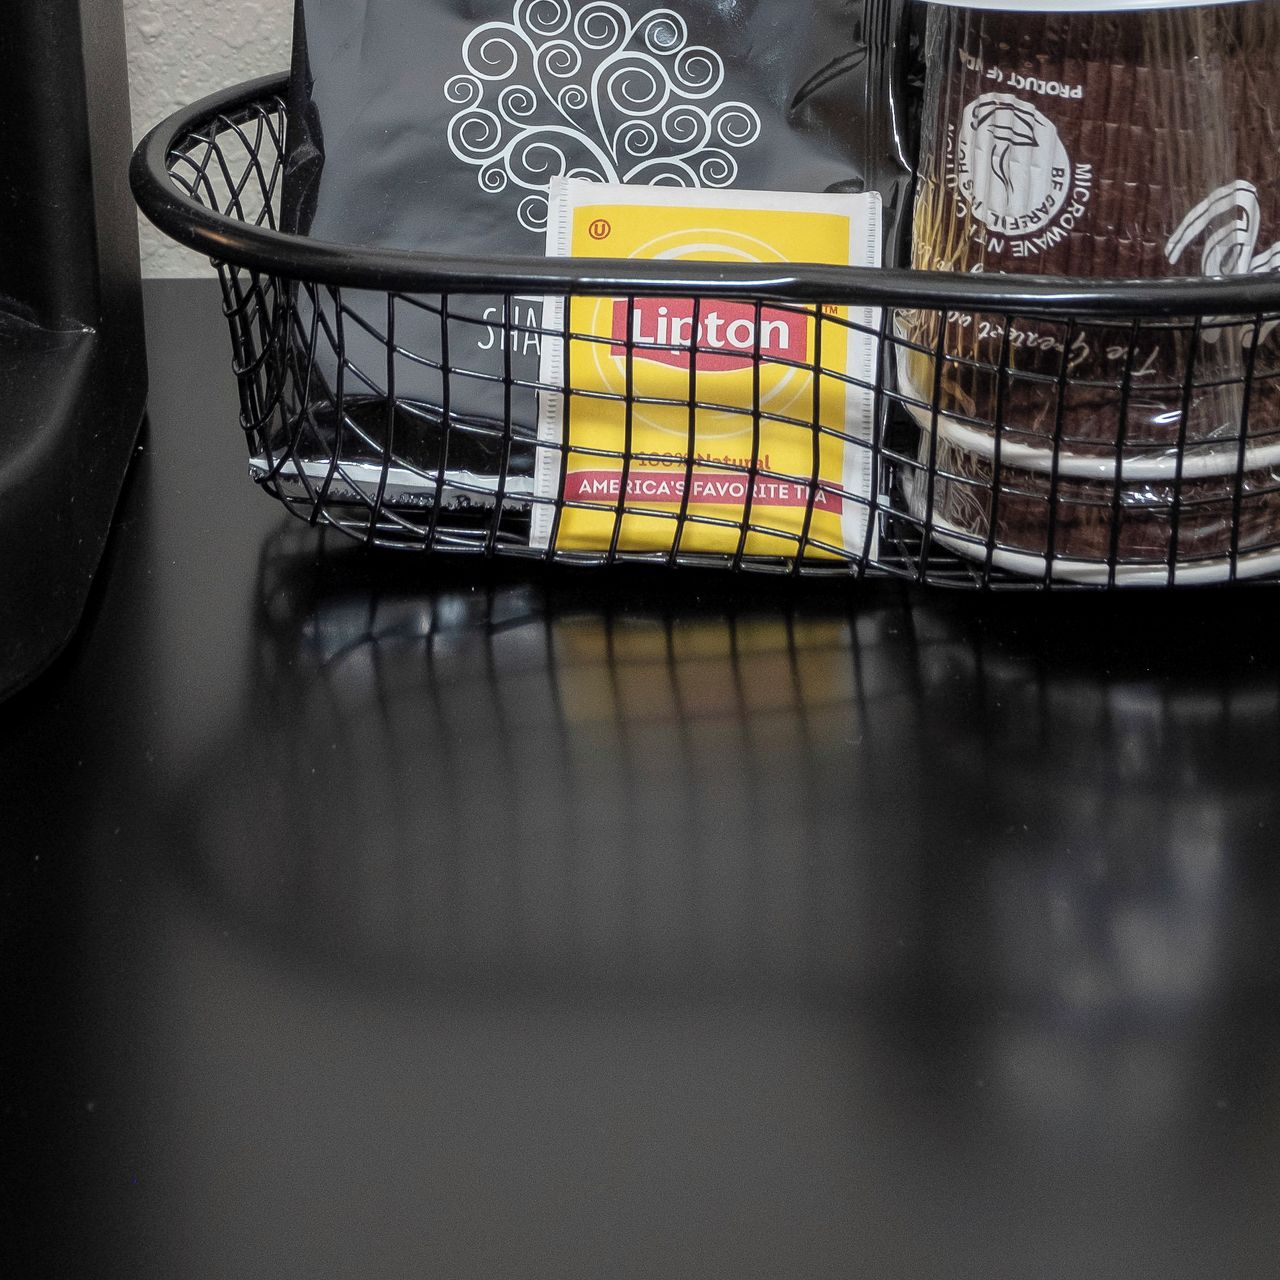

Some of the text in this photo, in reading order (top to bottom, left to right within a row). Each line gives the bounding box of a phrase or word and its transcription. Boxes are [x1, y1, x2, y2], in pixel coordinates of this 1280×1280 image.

[1010, 163, 1094, 258] MICROWAVE
[632, 306, 789, 356] Lipton
[1106, 345, 1160, 377] Te
[578, 478, 685, 497] AMERICA'S
[794, 484, 827, 504] TA
